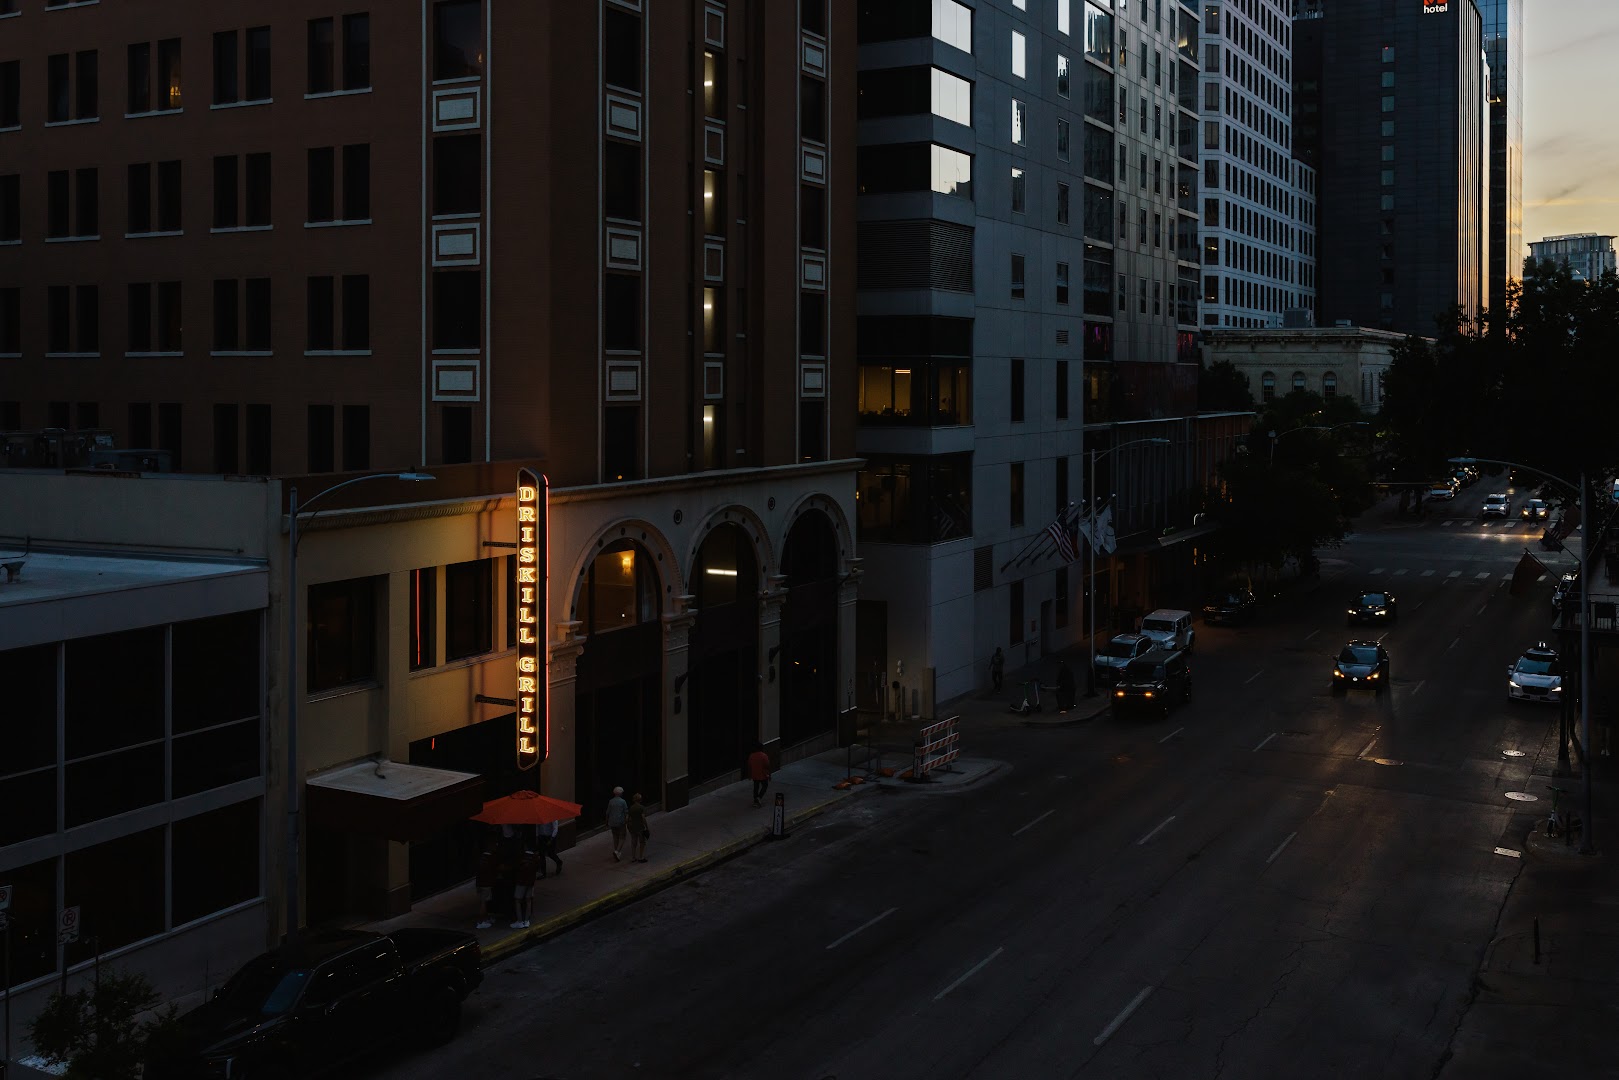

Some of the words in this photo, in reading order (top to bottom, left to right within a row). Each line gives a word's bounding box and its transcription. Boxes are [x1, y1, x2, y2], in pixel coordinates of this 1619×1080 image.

[1423, 3, 1448, 14] hotel
[518, 486, 536, 644] DRISKILL
[518, 656, 536, 753] GRILL
